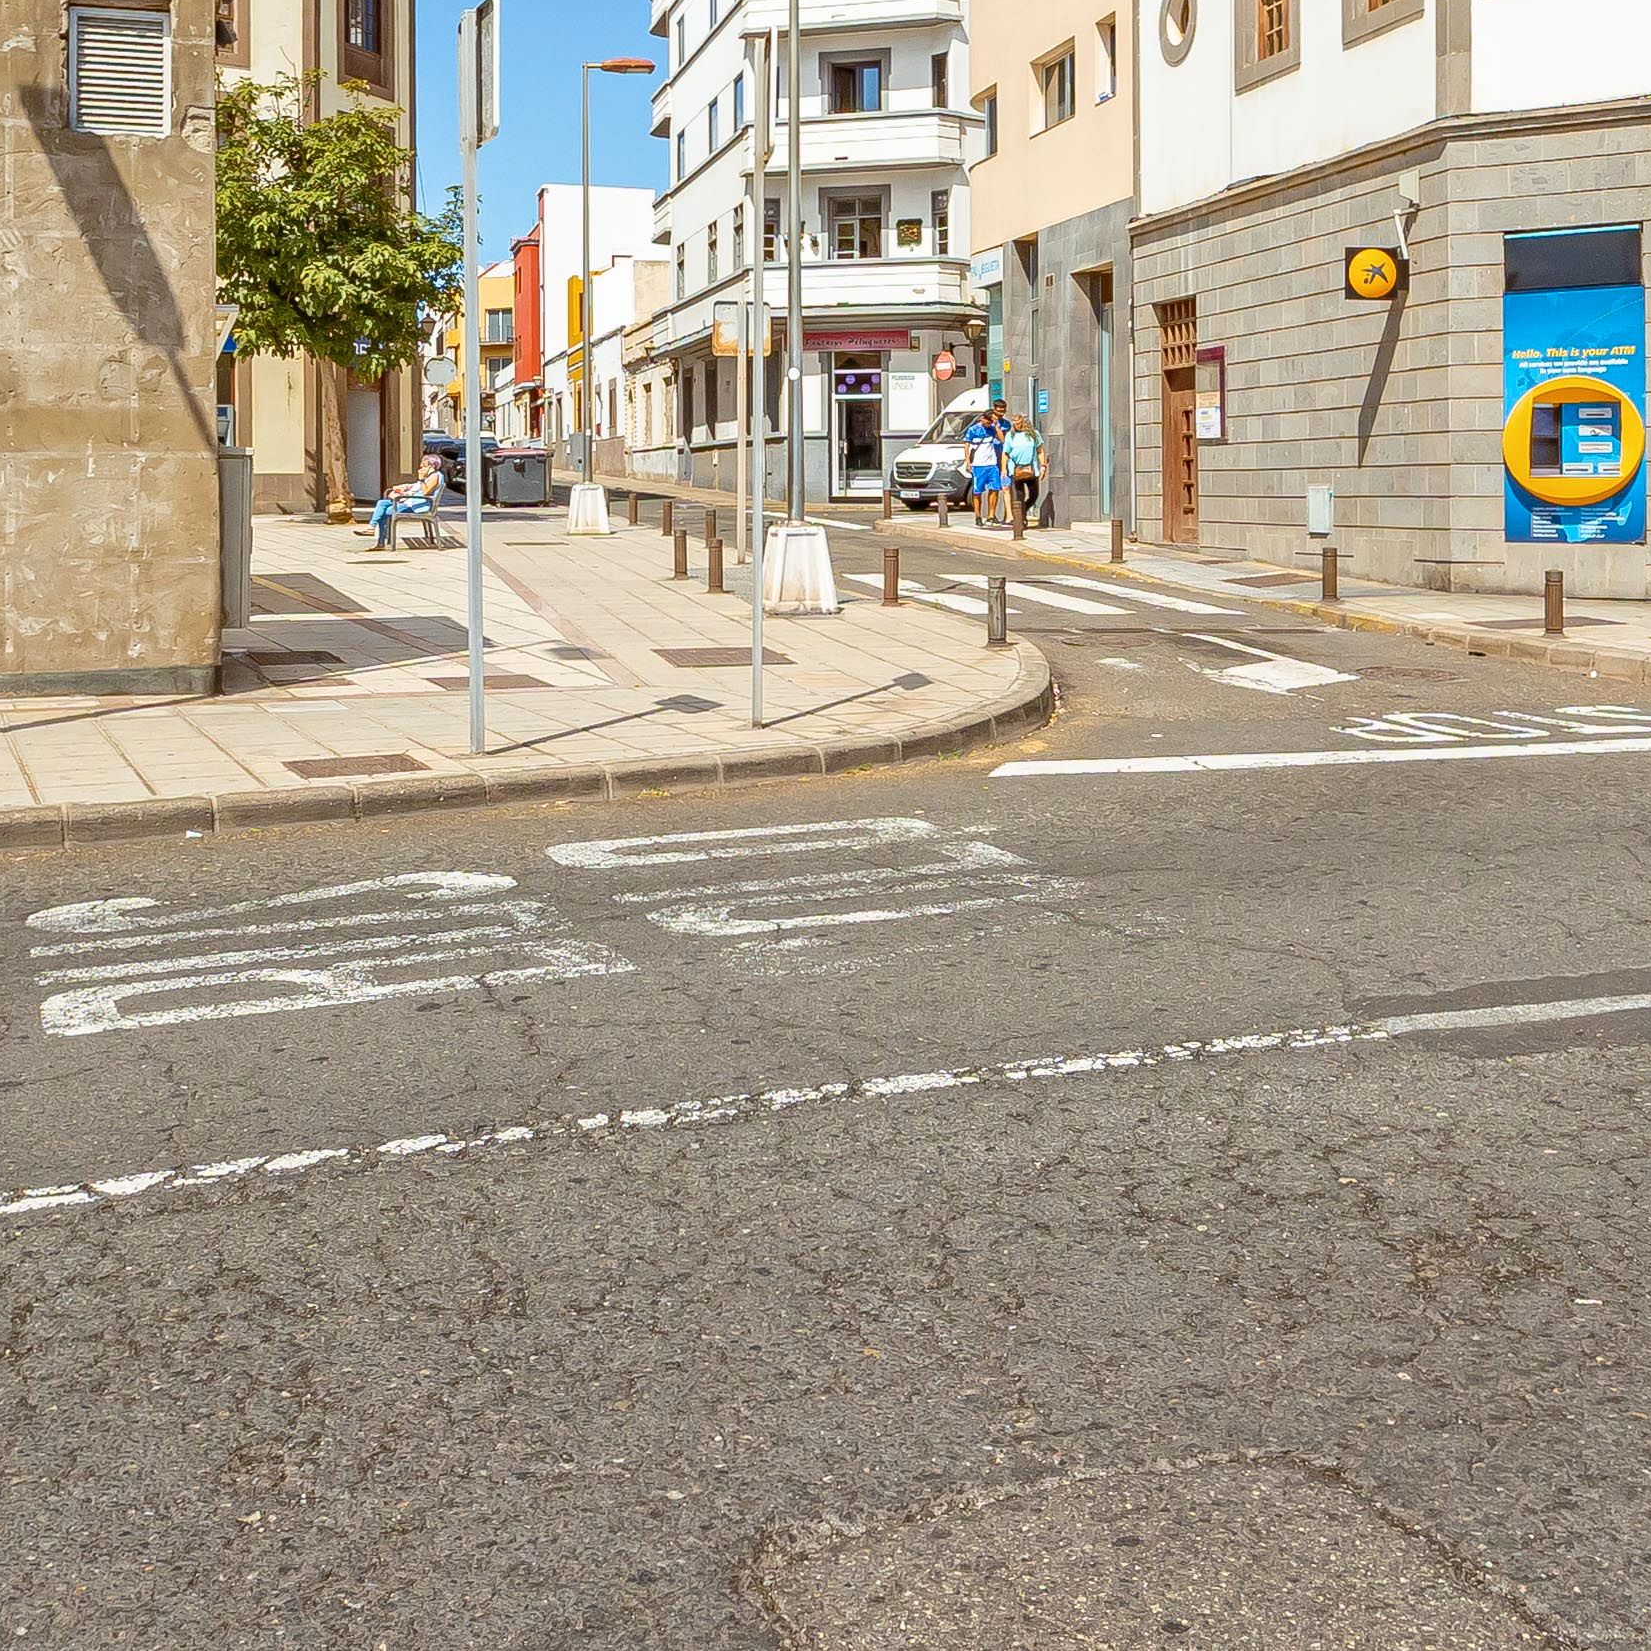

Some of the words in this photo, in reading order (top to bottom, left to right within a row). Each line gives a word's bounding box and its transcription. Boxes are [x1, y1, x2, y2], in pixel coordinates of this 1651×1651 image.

[1546, 348, 1568, 358] This
[1570, 348, 1580, 356] is
[1581, 348, 1609, 359] your
[1610, 345, 1636, 356] ATM
